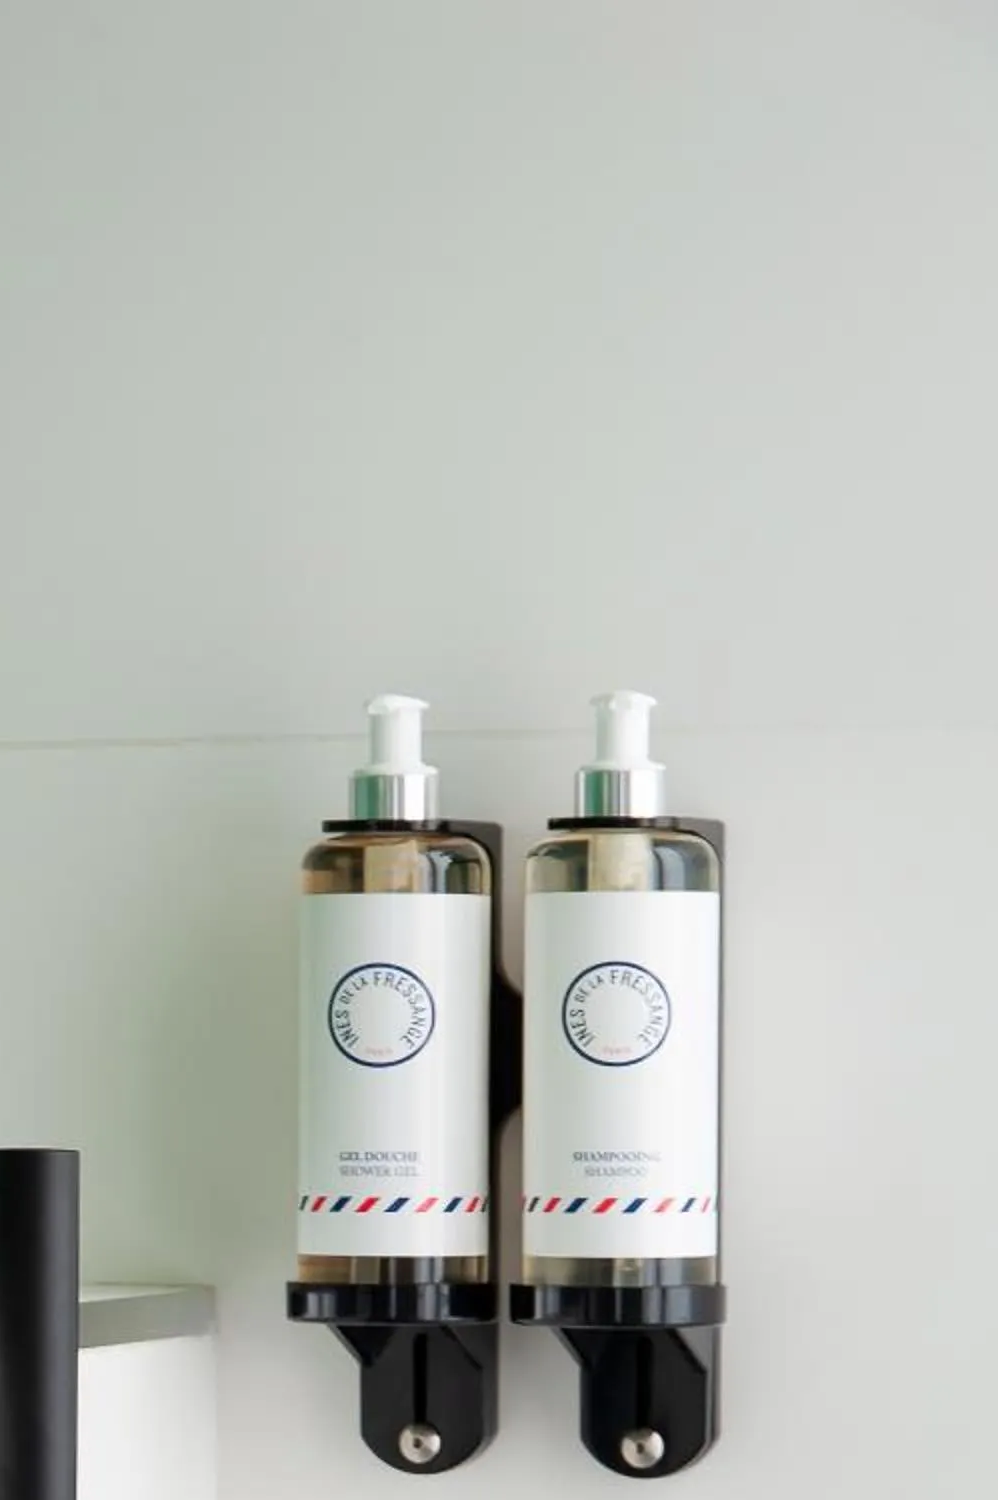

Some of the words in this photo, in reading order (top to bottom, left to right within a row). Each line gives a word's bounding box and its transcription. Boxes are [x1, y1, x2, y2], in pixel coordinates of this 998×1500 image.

[335, 1009, 359, 1048] INES
[373, 972, 427, 1050] FRESSANGE
[570, 1008, 596, 1048] INES
[610, 969, 664, 1049] FRESSANGE
